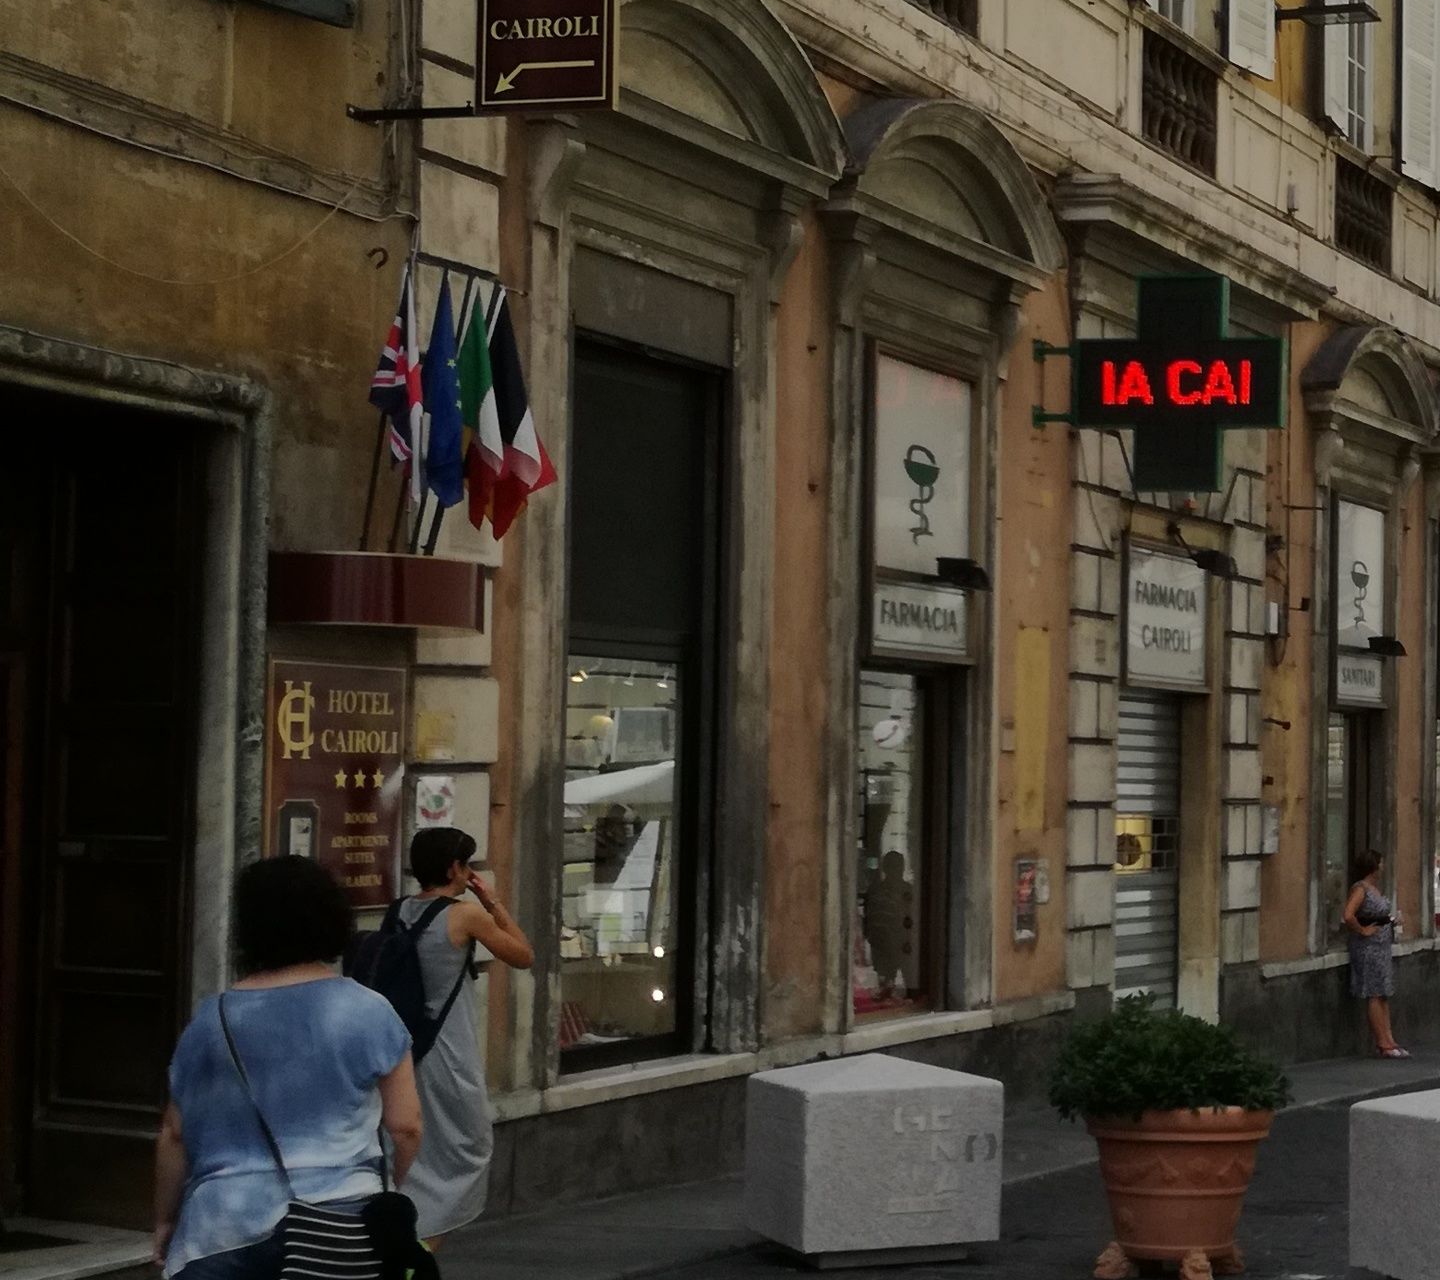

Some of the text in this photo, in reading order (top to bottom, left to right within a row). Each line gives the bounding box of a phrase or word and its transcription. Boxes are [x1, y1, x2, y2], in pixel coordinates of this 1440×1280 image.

[490, 14, 600, 41] CAIROLI
[1134, 579, 1198, 614] FARMACIA
[879, 598, 958, 634] FARMACIA
[1140, 623, 1192, 656] CAIROLI
[328, 688, 395, 716] HOTEL
[321, 728, 399, 756] CAIROLI
